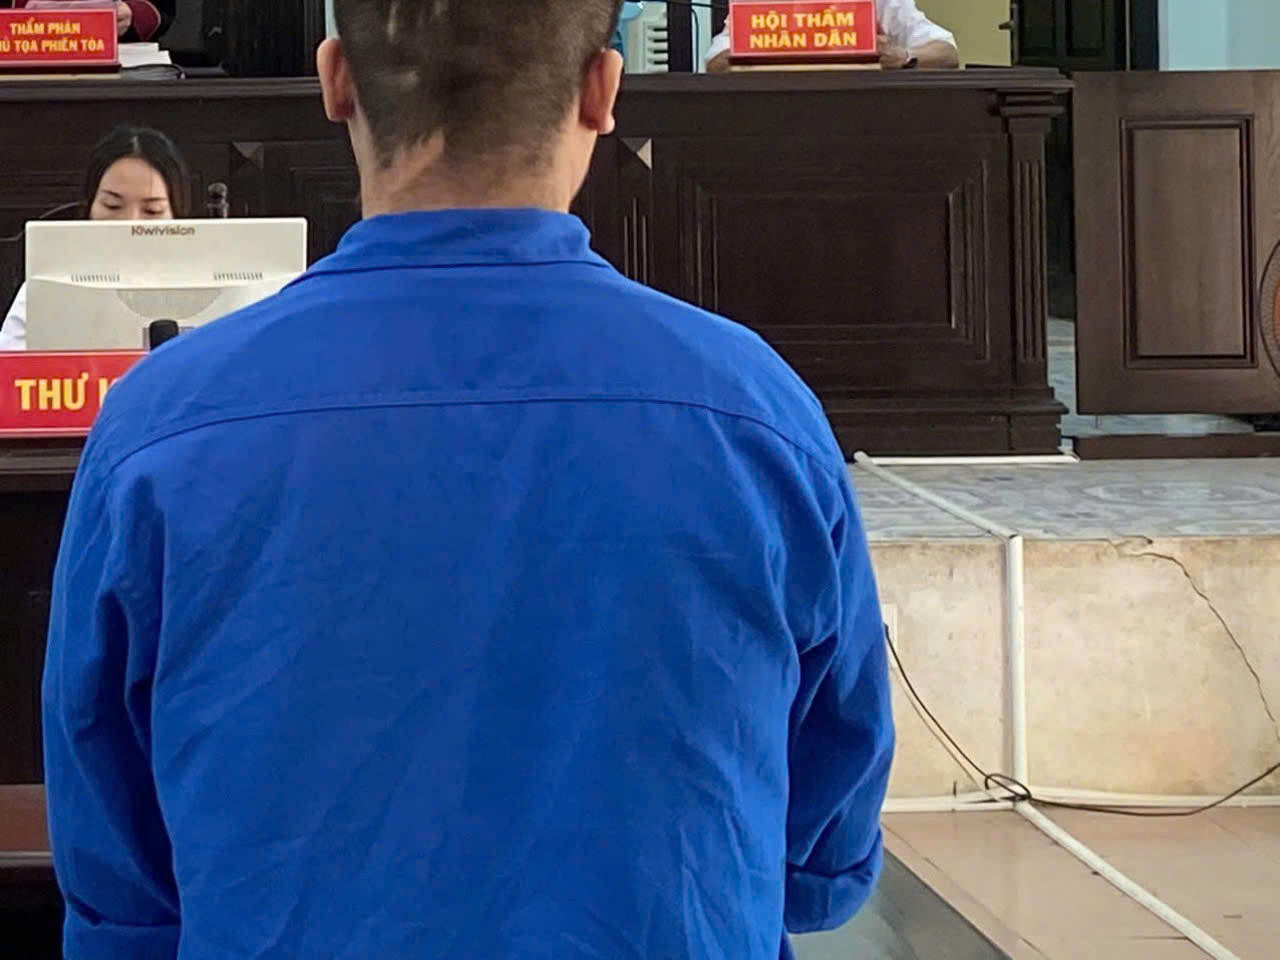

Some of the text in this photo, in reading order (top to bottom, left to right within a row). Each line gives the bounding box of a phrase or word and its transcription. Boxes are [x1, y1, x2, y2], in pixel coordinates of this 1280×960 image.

[750, 4, 855, 31] HỘI THẨM
[748, 28, 858, 49] NHÂN DÂN
[14, 371, 90, 411] THƯ
